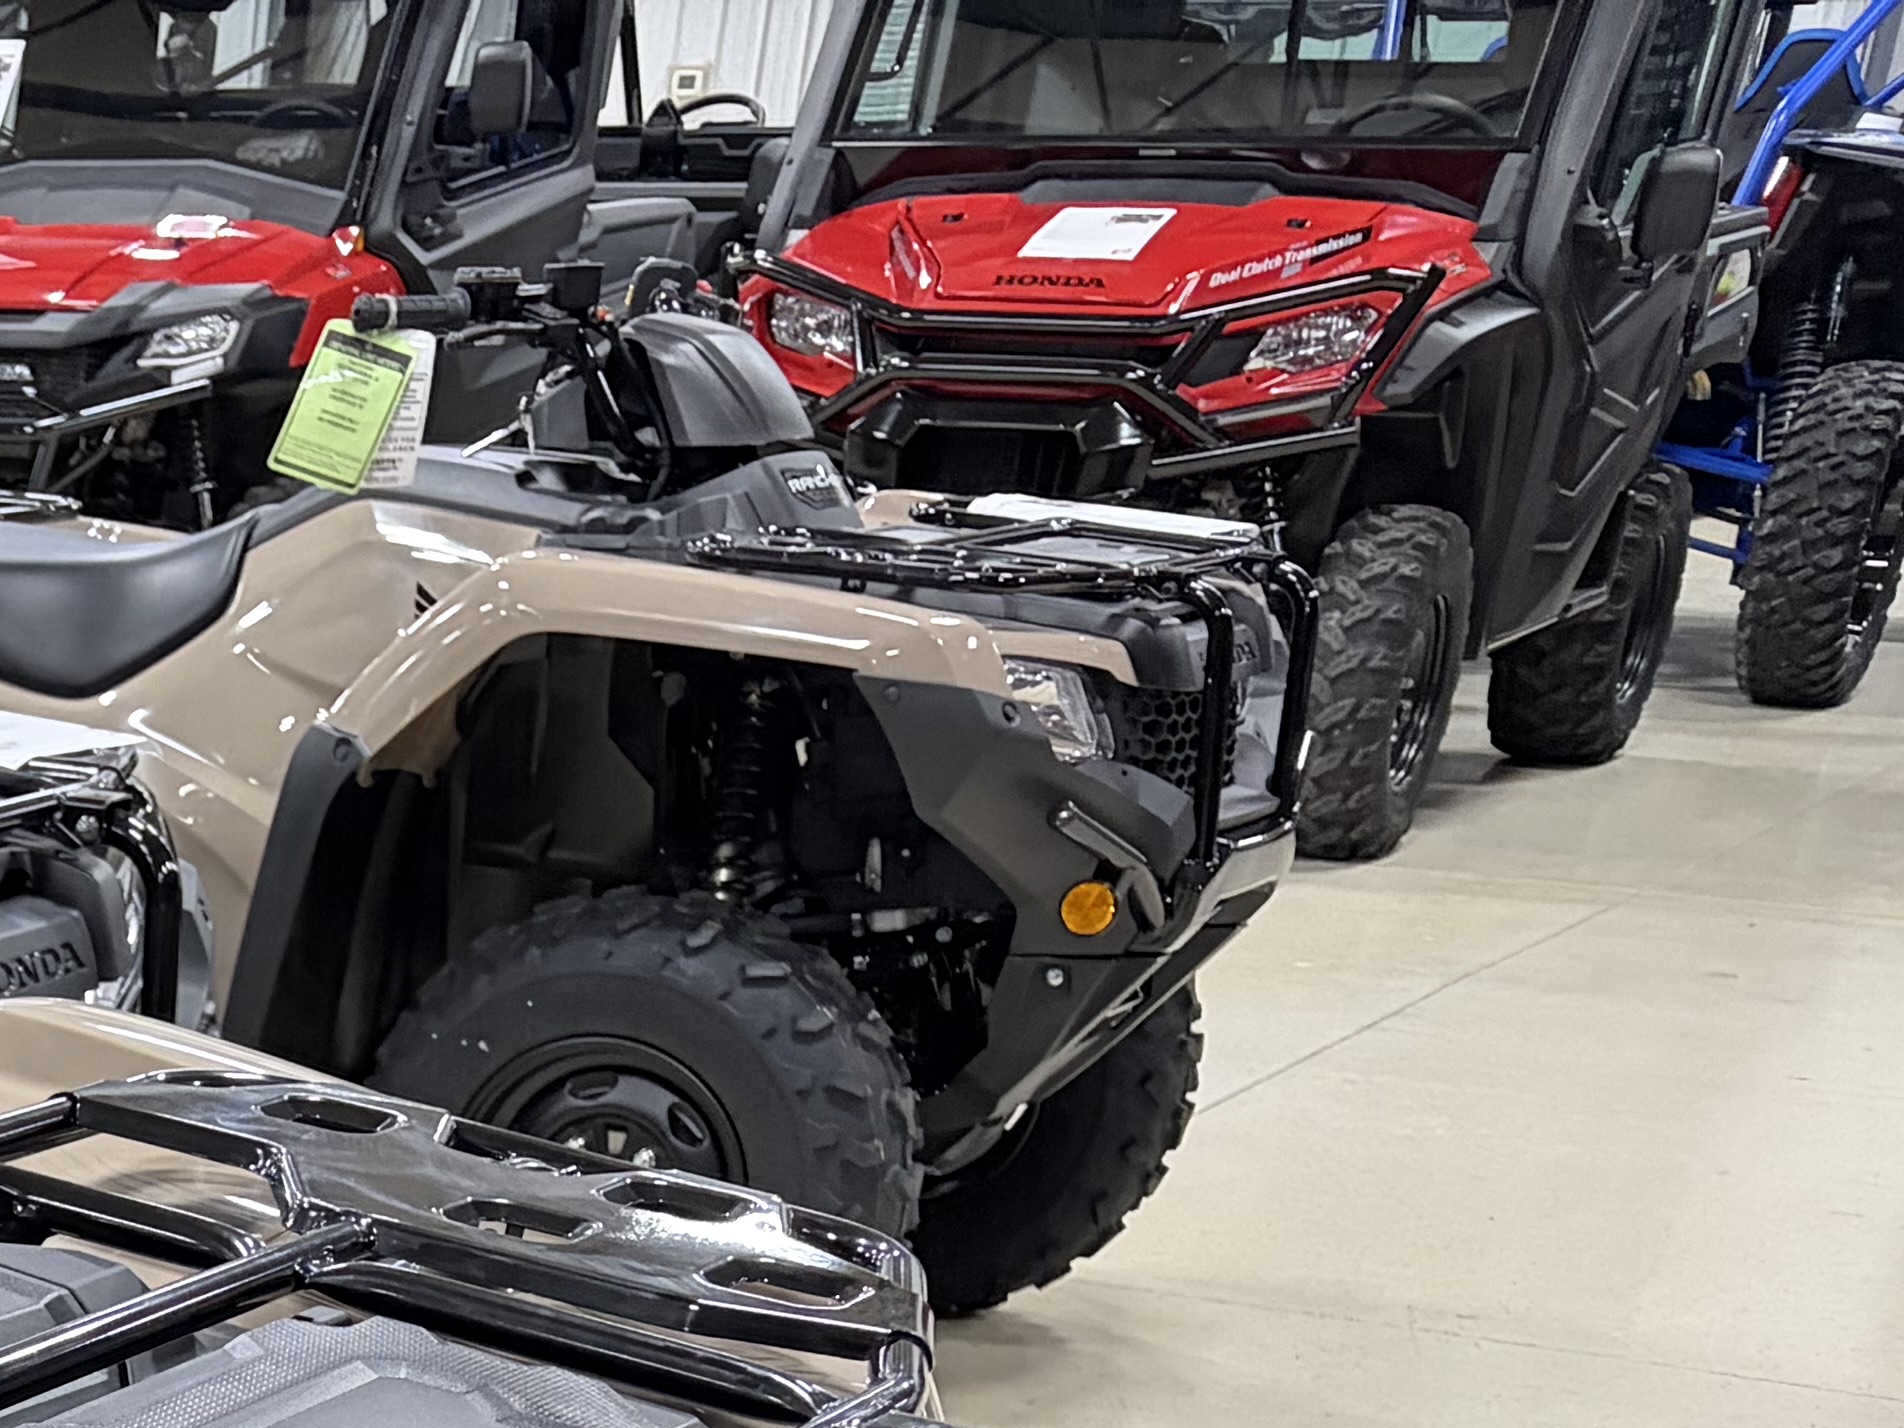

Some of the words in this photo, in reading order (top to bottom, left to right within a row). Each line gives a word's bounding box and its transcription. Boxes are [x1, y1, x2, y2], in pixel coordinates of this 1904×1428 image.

[1209, 266, 1242, 289] Dual
[1243, 254, 1283, 279] Clutch
[1284, 231, 1364, 264] Transmission
[994, 274, 1106, 289] HONDA
